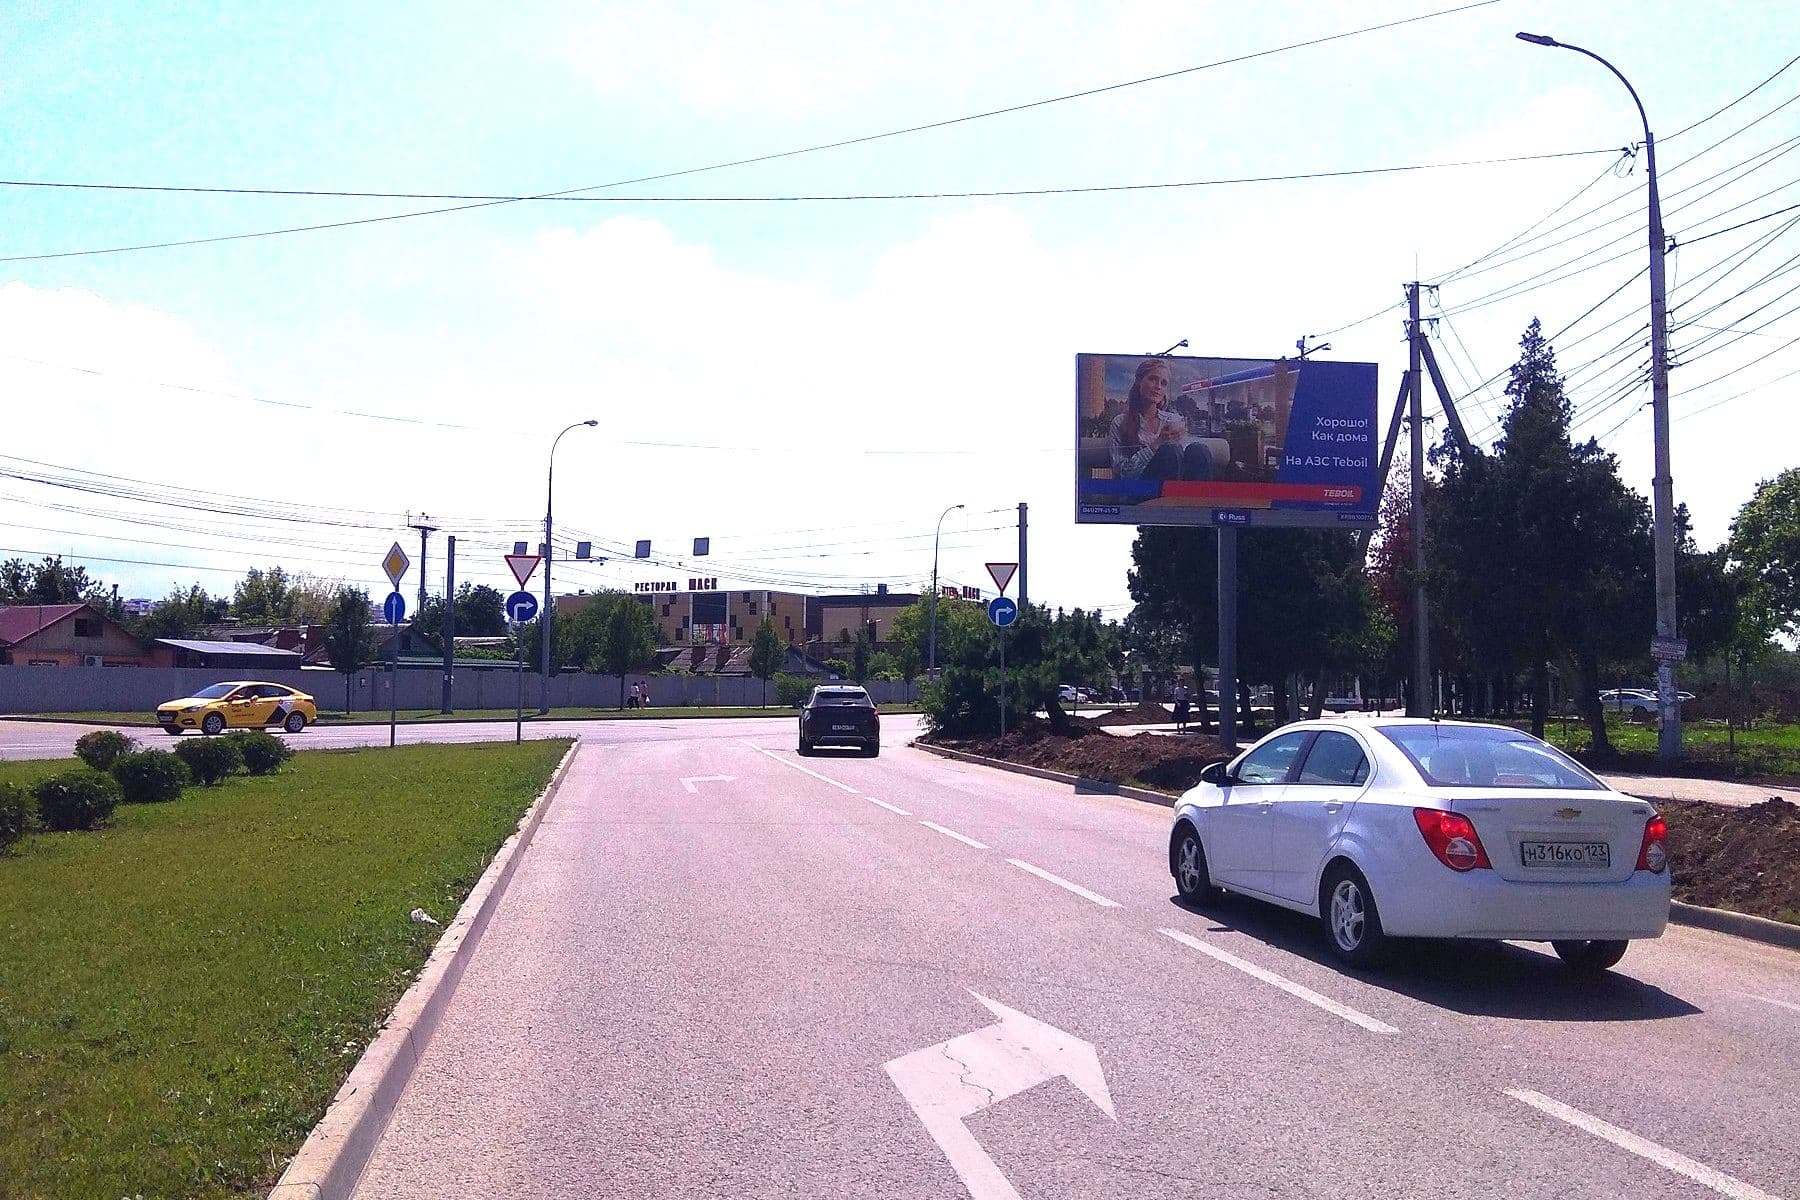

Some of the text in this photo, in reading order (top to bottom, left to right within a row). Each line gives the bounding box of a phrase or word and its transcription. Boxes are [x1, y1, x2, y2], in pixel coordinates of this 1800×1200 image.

[1316, 416, 1368, 429] Хорошо!
[1312, 431, 1368, 442] Как дома
[1286, 455, 1368, 467] На АЗС Teboil
[1323, 489, 1354, 498] TEBOIL
[634, 581, 677, 592] РЕСТОРАН
